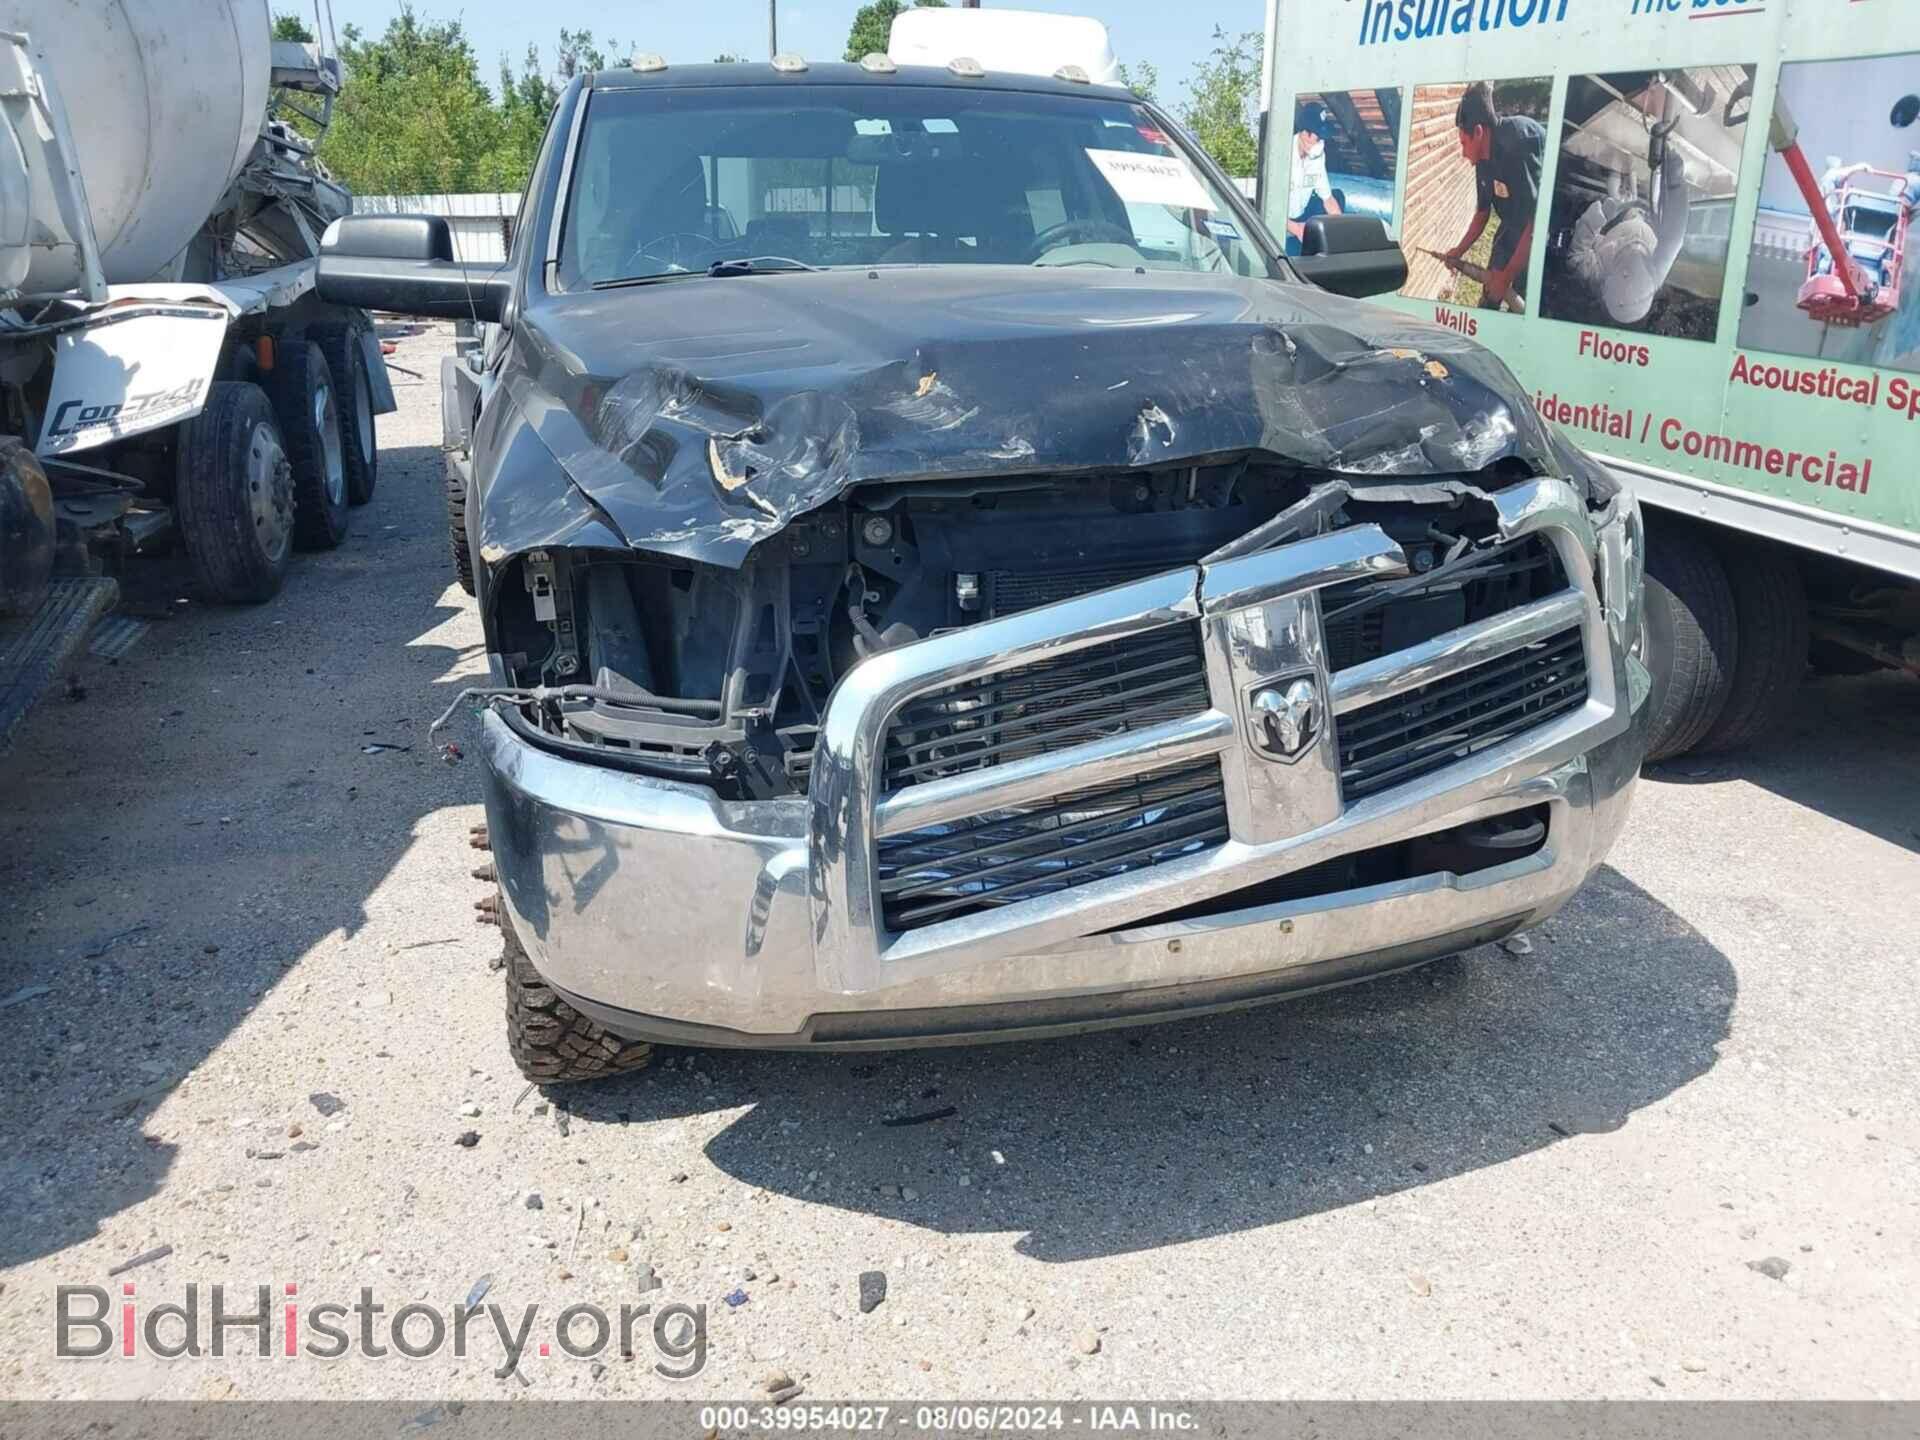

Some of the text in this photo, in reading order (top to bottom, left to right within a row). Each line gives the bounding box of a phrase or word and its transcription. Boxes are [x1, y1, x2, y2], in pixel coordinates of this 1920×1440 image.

[1358, 0, 1569, 45] Insulation
[1435, 306, 1477, 336] Walls
[1579, 331, 1649, 366] Floors
[1730, 355, 1880, 405] Acoustical
[1660, 418, 1872, 494] Commercial
